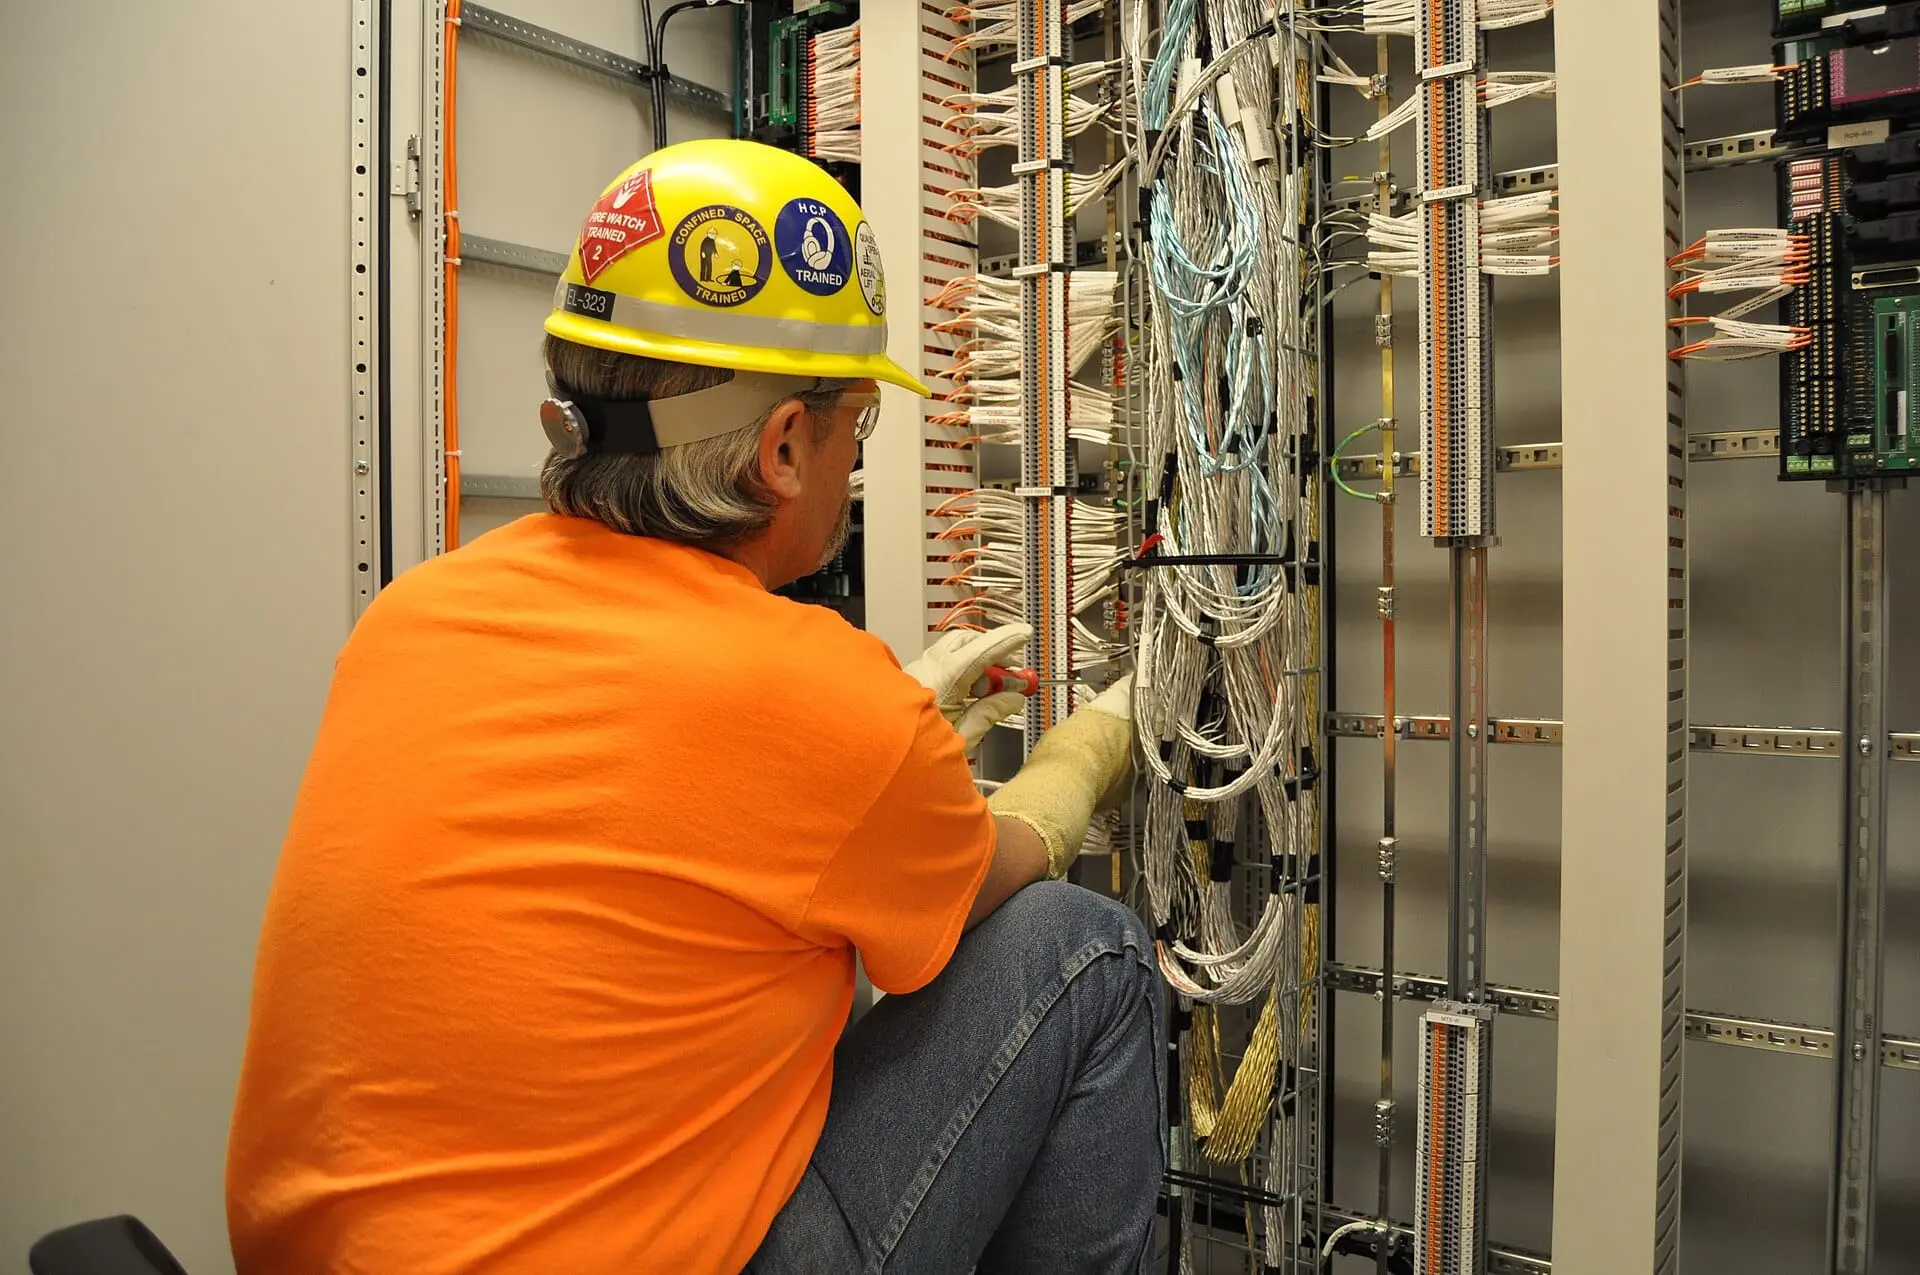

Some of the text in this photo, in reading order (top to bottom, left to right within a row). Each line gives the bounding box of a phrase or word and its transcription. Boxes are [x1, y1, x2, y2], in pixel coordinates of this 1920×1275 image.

[606, 212, 647, 232] WATCH
[675, 208, 767, 246] CONFINED SPACE
[588, 226, 626, 243] TRAINED
[592, 245, 603, 260] 2
[795, 269, 843, 287] TRAINED
[567, 288, 607, 313] EL-323
[694, 285, 748, 304] TRAINED
